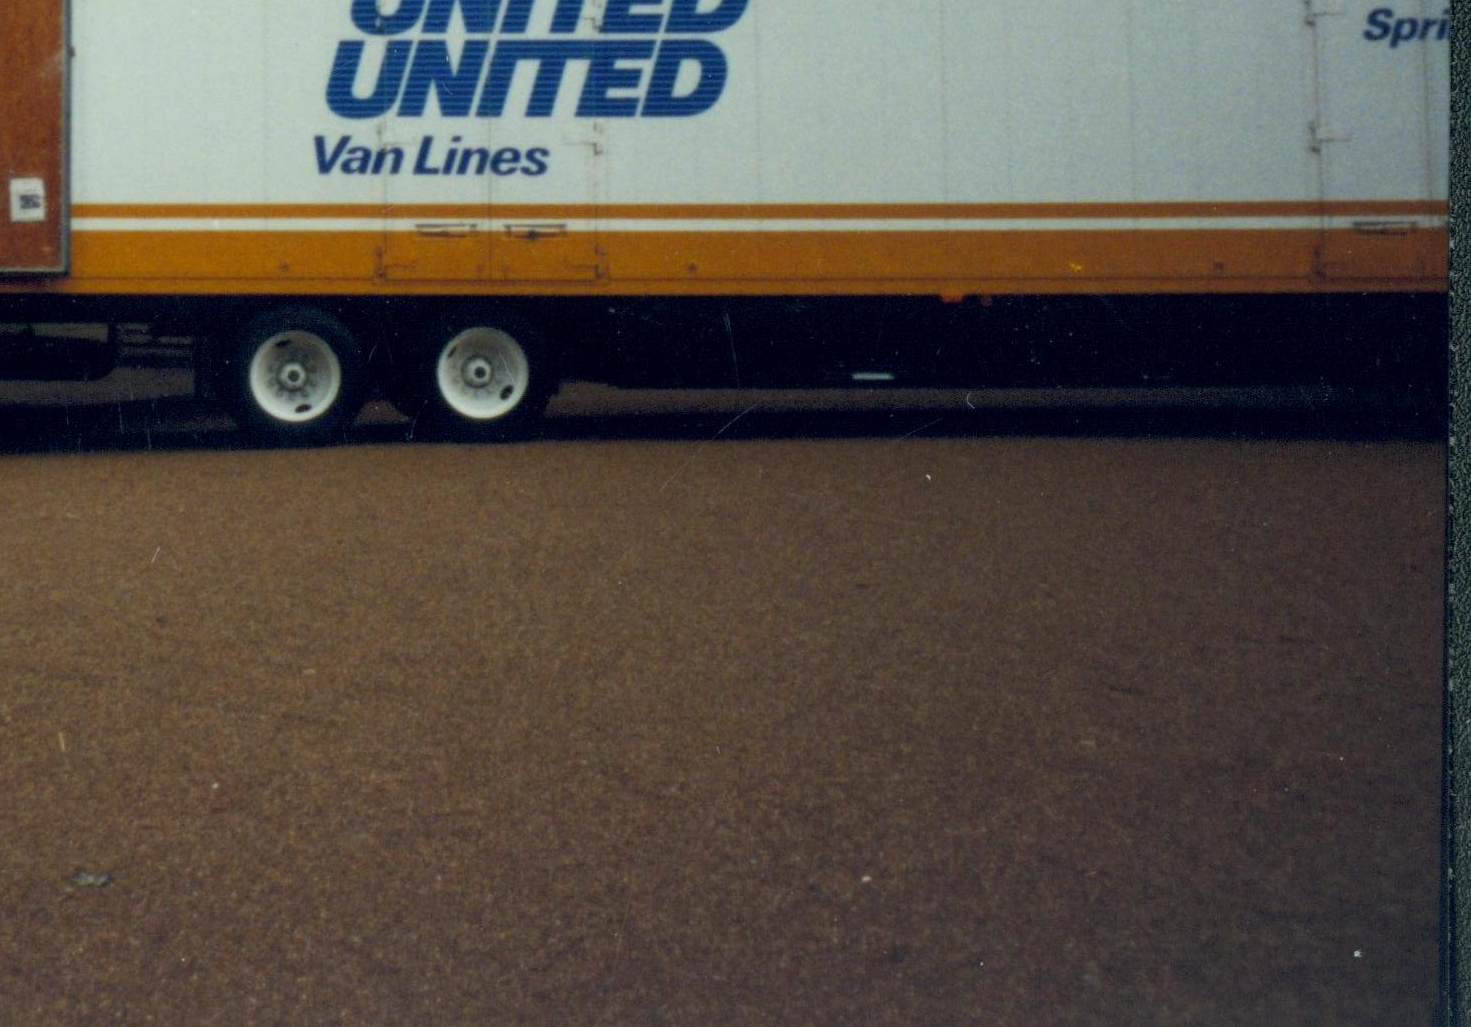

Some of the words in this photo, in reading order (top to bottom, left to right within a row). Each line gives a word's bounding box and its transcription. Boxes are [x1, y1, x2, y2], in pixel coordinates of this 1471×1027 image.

[1363, 8, 1449, 48] Spri
[325, 39, 728, 119] UNITED
[313, 135, 405, 176] Van
[412, 135, 550, 176] Lines
